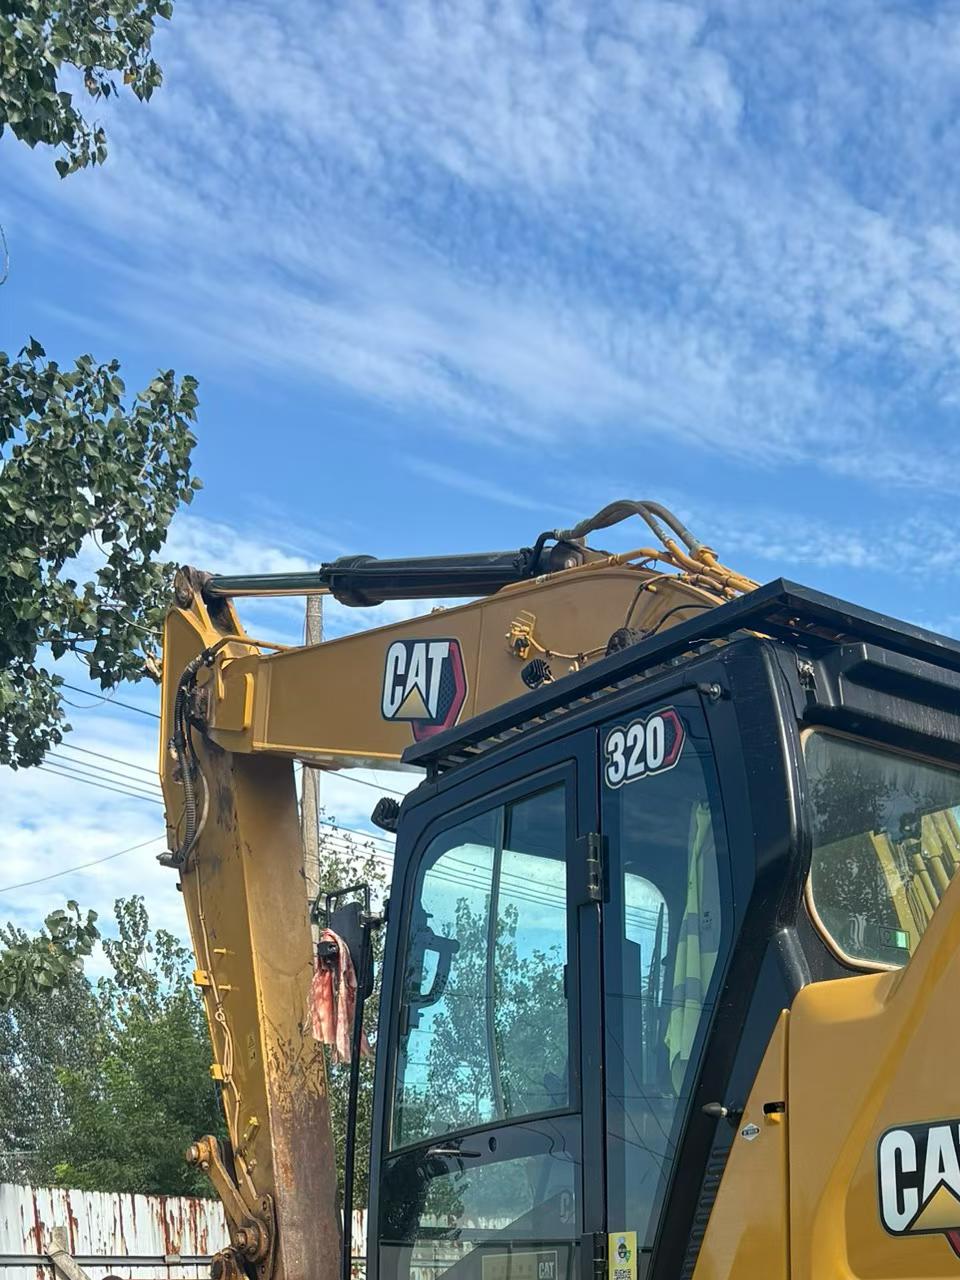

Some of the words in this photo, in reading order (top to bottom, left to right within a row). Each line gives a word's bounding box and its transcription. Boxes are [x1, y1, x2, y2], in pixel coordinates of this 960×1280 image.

[381, 641, 450, 719] CAT
[607, 715, 666, 783] 320
[538, 1261, 555, 1279] CAT
